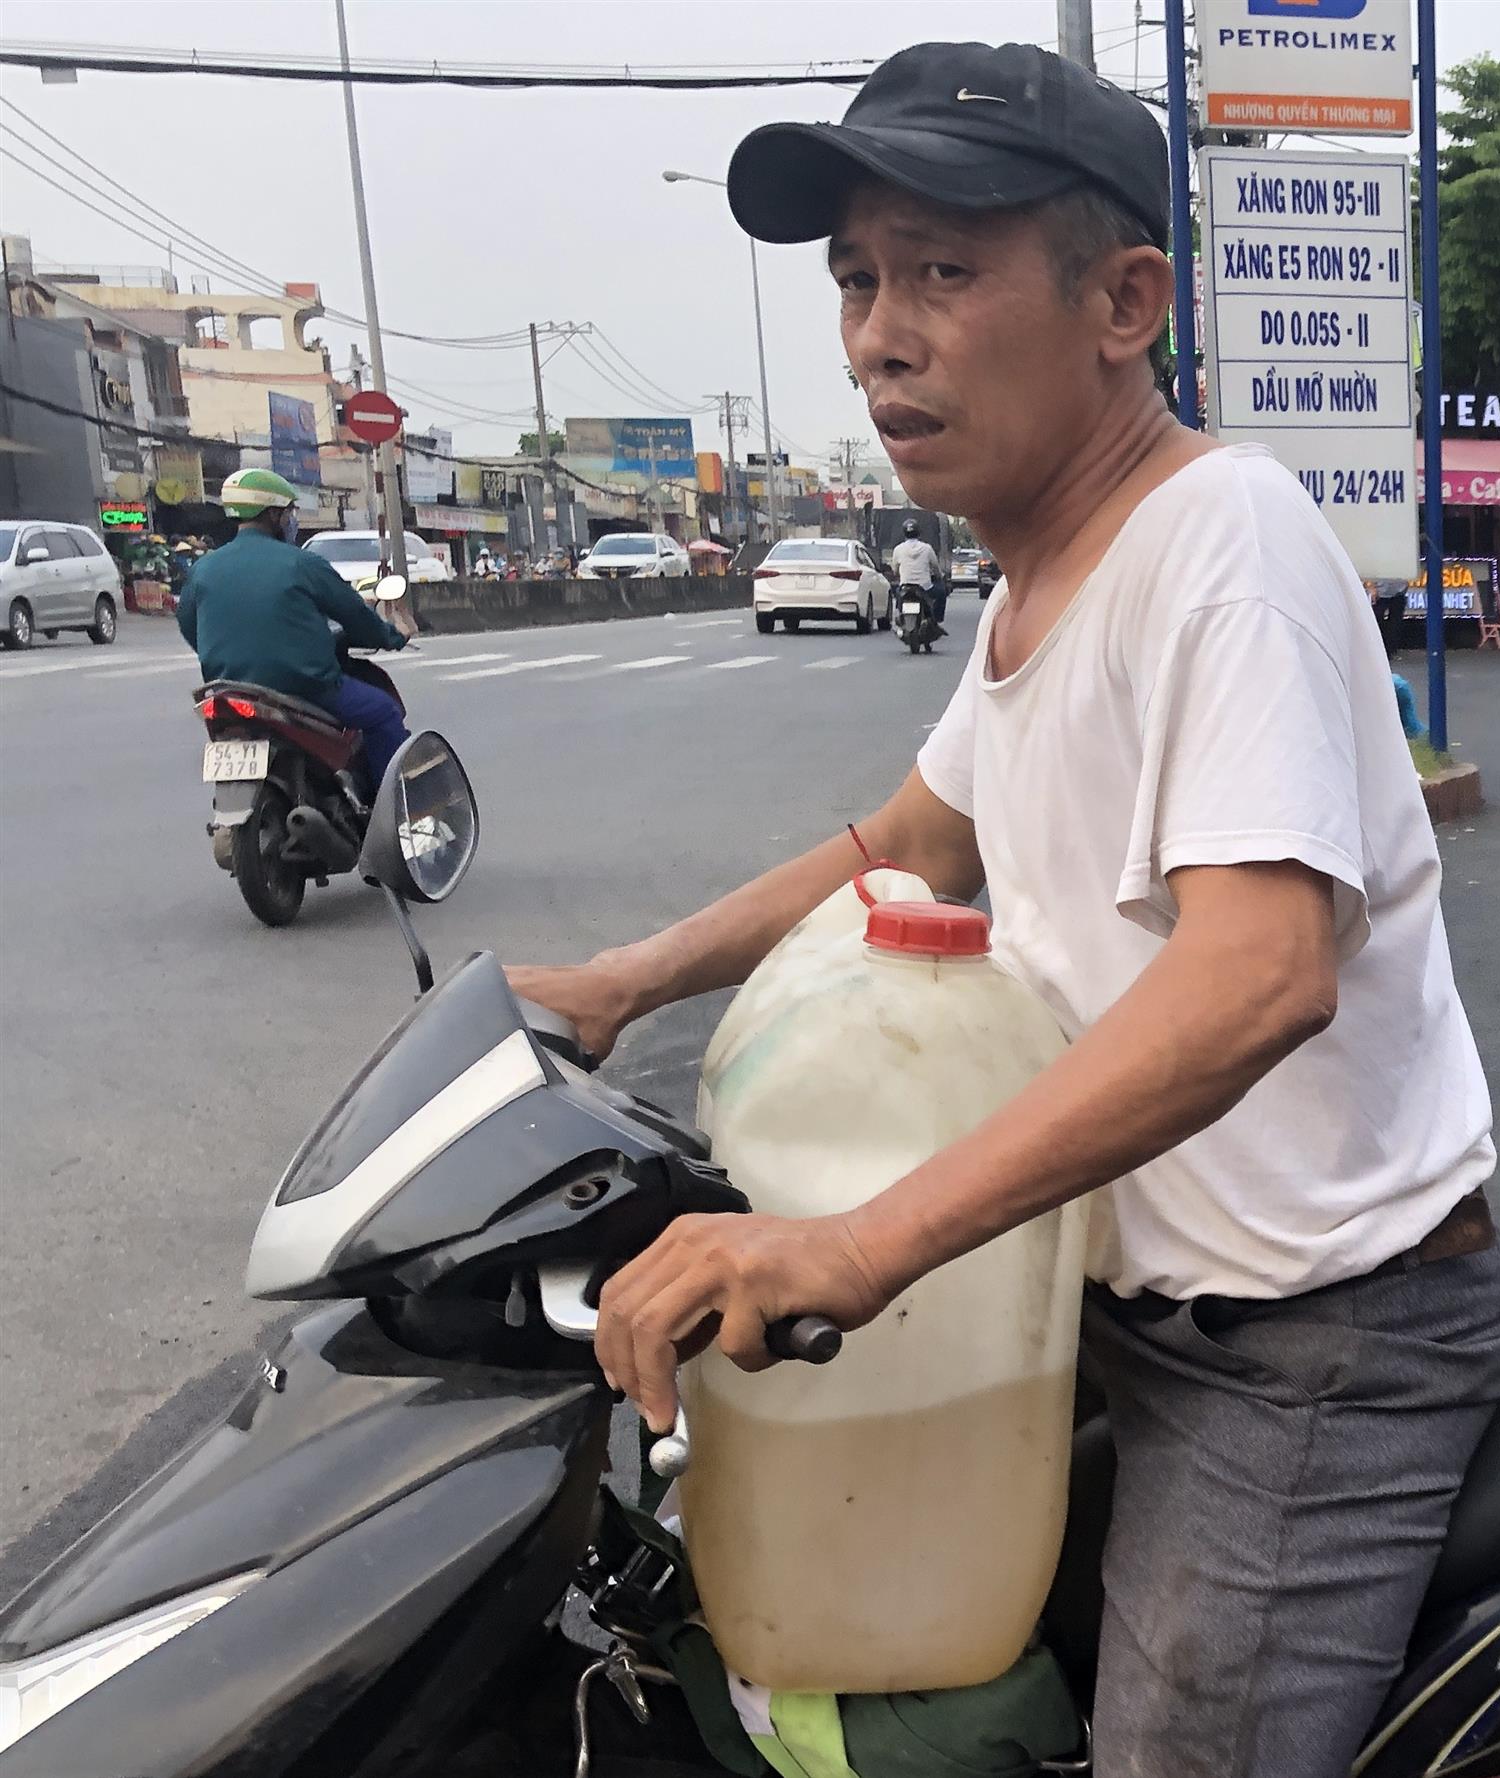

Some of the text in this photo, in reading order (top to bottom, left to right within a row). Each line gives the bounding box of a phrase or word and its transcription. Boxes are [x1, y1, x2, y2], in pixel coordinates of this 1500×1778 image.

[1219, 28, 1397, 52] PETROLIMEX
[1236, 172, 1381, 216] XĂNG RON 95-III
[1223, 238, 1273, 280] XĂNG
[1279, 247, 1301, 281] E5
[1308, 246, 1344, 281] RON
[1349, 248, 1372, 282] 92
[1260, 310, 1285, 345] DO
[1290, 311, 1341, 347] 0.05S
[1252, 366, 1378, 412] DẦU MỠ NHỜN
[1333, 470, 1405, 504] 24/24H
